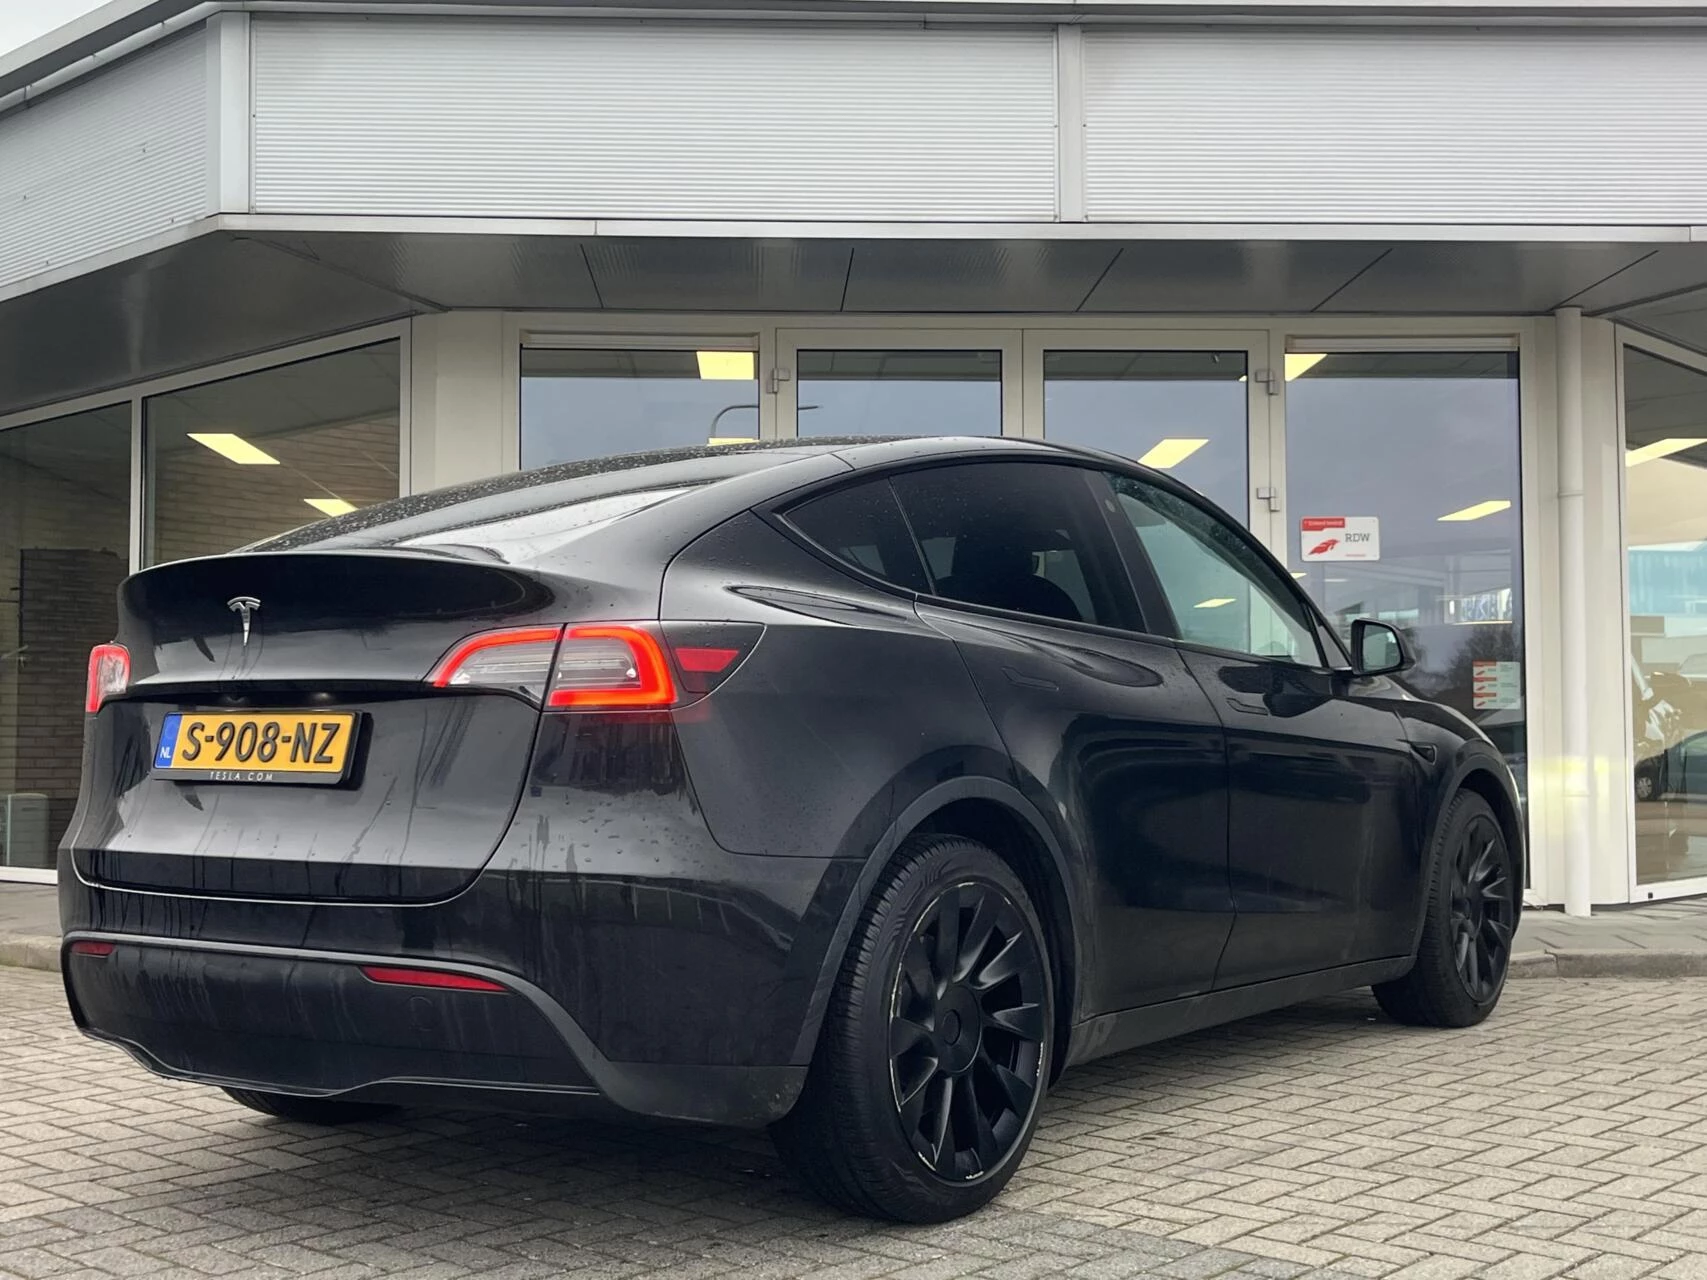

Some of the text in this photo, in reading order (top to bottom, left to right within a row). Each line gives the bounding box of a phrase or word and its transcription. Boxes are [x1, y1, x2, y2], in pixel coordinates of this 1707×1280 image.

[1345, 533, 1370, 542] RDW
[182, 722, 340, 763] S-908-NZ
[159, 746, 171, 759] NL
